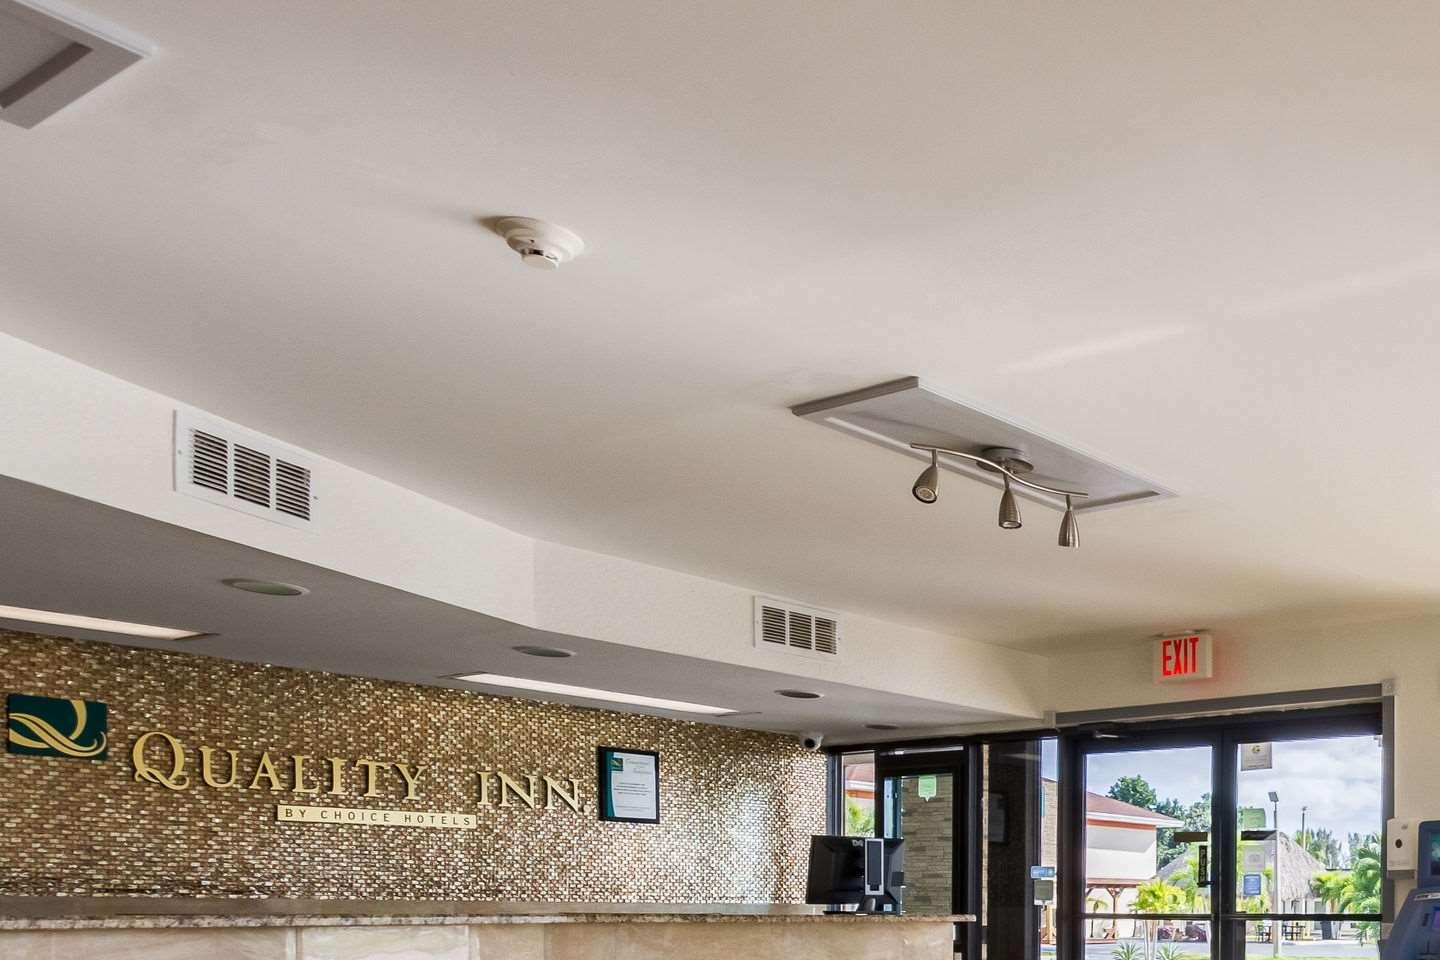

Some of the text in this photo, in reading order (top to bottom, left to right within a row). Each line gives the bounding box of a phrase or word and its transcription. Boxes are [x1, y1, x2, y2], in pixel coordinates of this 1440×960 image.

[1162, 636, 1200, 677] EXIT
[132, 731, 431, 801] QUALITY
[285, 807, 472, 826] BY CHOICE HOTELS
